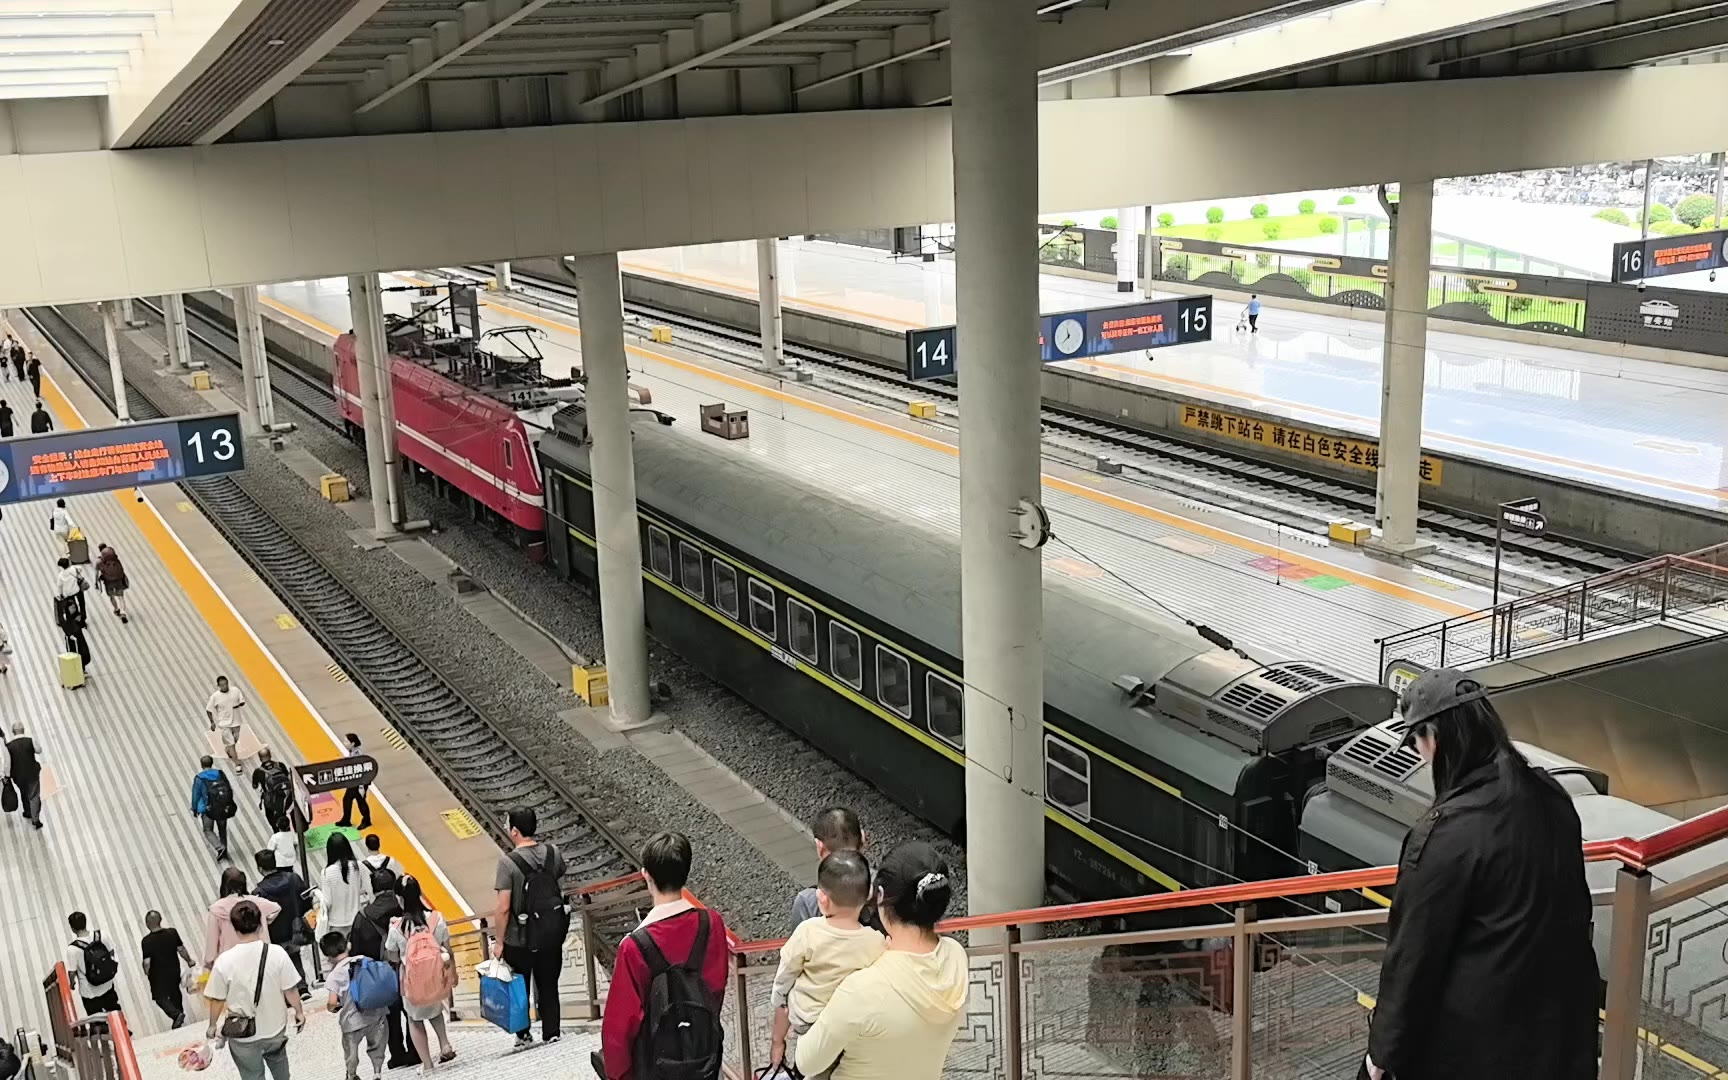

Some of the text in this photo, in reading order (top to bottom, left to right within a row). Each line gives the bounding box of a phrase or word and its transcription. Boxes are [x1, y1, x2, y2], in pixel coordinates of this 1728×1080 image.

[1621, 249, 1641, 272] 16
[1180, 307, 1208, 333] 15
[916, 339, 949, 369] 14
[510, 391, 532, 402] 141
[1184, 406, 1265, 441] 严禁跳下站台
[187, 428, 236, 464] 13
[333, 761, 374, 777] 便捷换乘
[334, 773, 363, 783] Transfer
